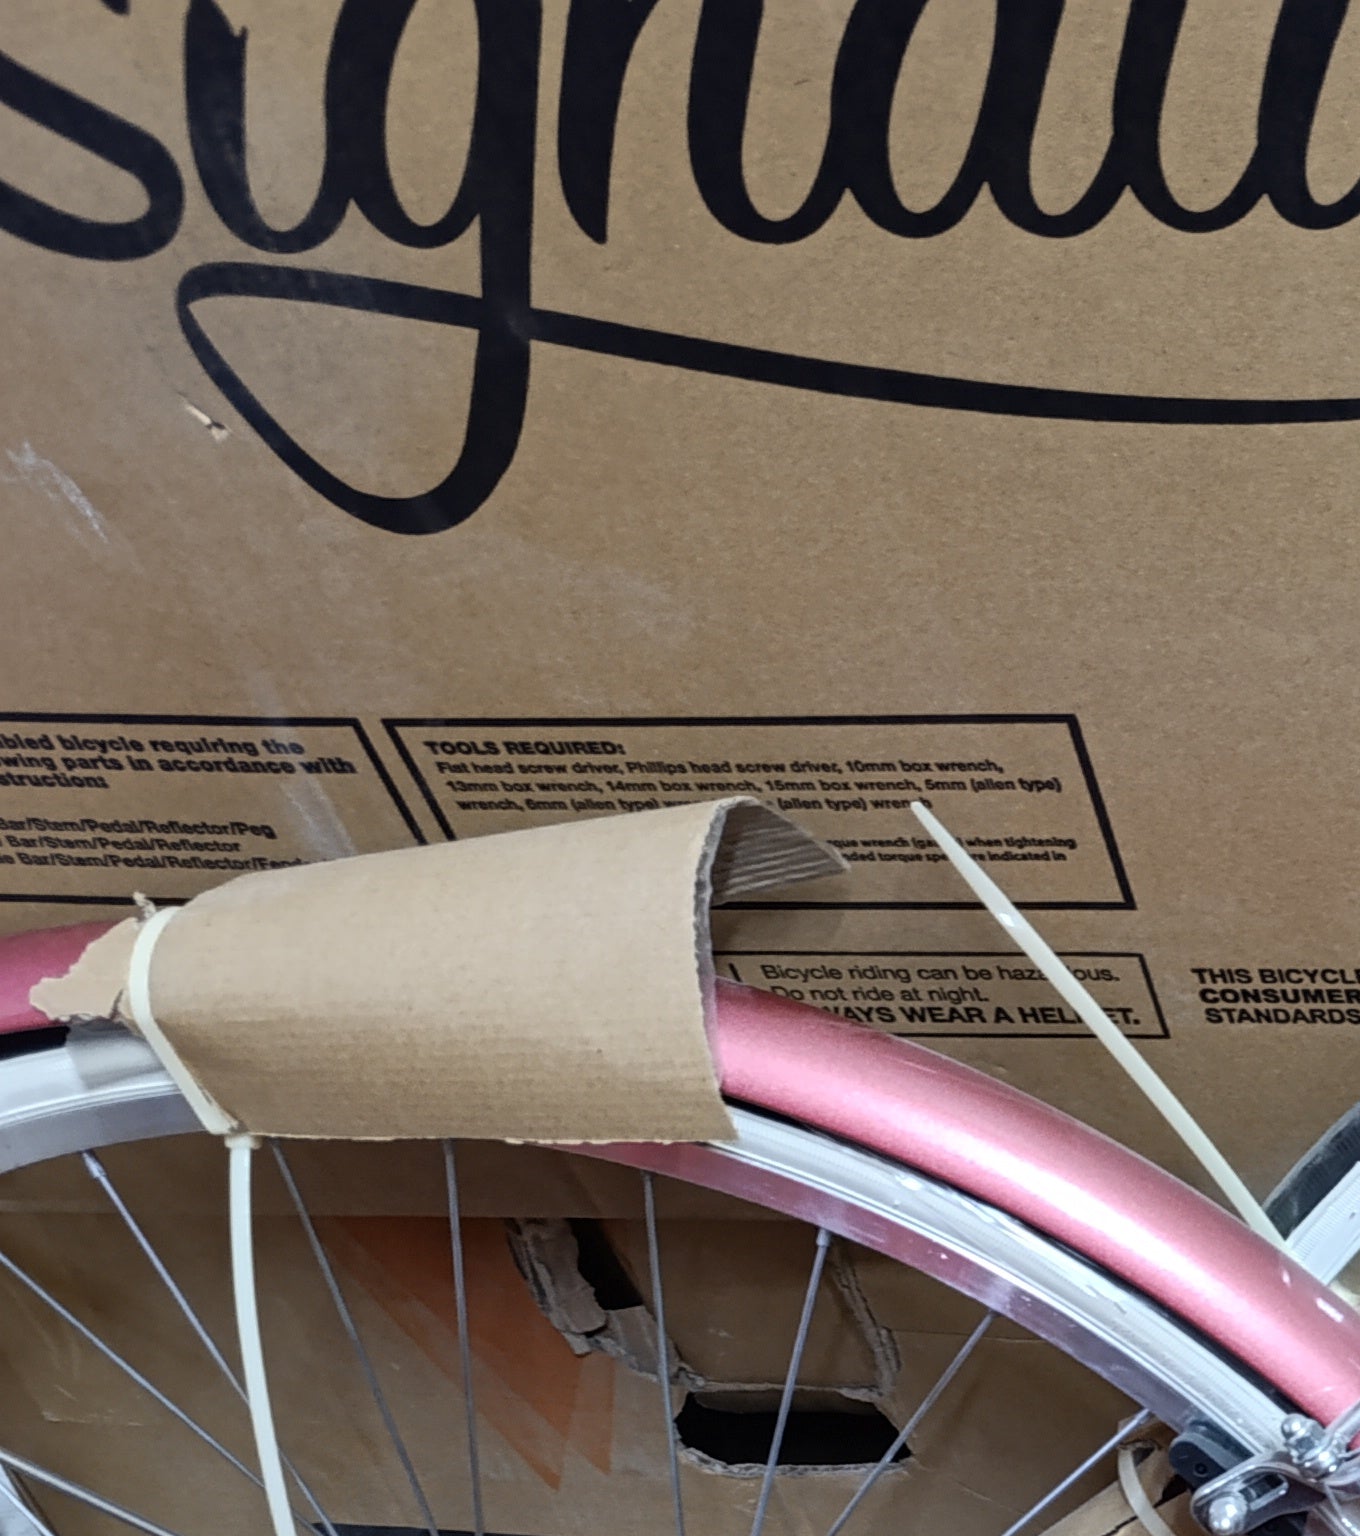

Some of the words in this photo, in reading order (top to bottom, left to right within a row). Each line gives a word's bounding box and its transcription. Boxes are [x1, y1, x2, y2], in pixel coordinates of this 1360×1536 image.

[55, 734, 146, 755] bicycle
[148, 736, 260, 758] requiring
[261, 738, 306, 755] the
[422, 740, 501, 756] TOOLS
[501, 740, 627, 756] REQUIRED:
[60, 753, 125, 774] parts
[125, 754, 155, 772] in
[156, 754, 297, 775] accordance
[298, 756, 358, 775] with
[469, 761, 516, 775] head
[516, 763, 568, 775] screw
[570, 761, 625, 776] driver,
[687, 760, 733, 774] head
[734, 762, 787, 774] screw
[789, 760, 844, 775] driver,
[845, 759, 898, 773] 10mm
[897, 759, 934, 773] box
[933, 758, 1005, 775] wrench,
[759, 964, 843, 984] Bicycle
[847, 965, 912, 984] riding
[916, 968, 959, 981] can
[961, 965, 998, 981] be
[1190, 967, 1254, 985] THIS
[808, 986, 849, 1002] not
[850, 986, 896, 1002] ride
[899, 987, 924, 1002] at
[926, 986, 990, 1006] night.
[902, 1006, 988, 1024] WEAR
[993, 1006, 1016, 1024] A
